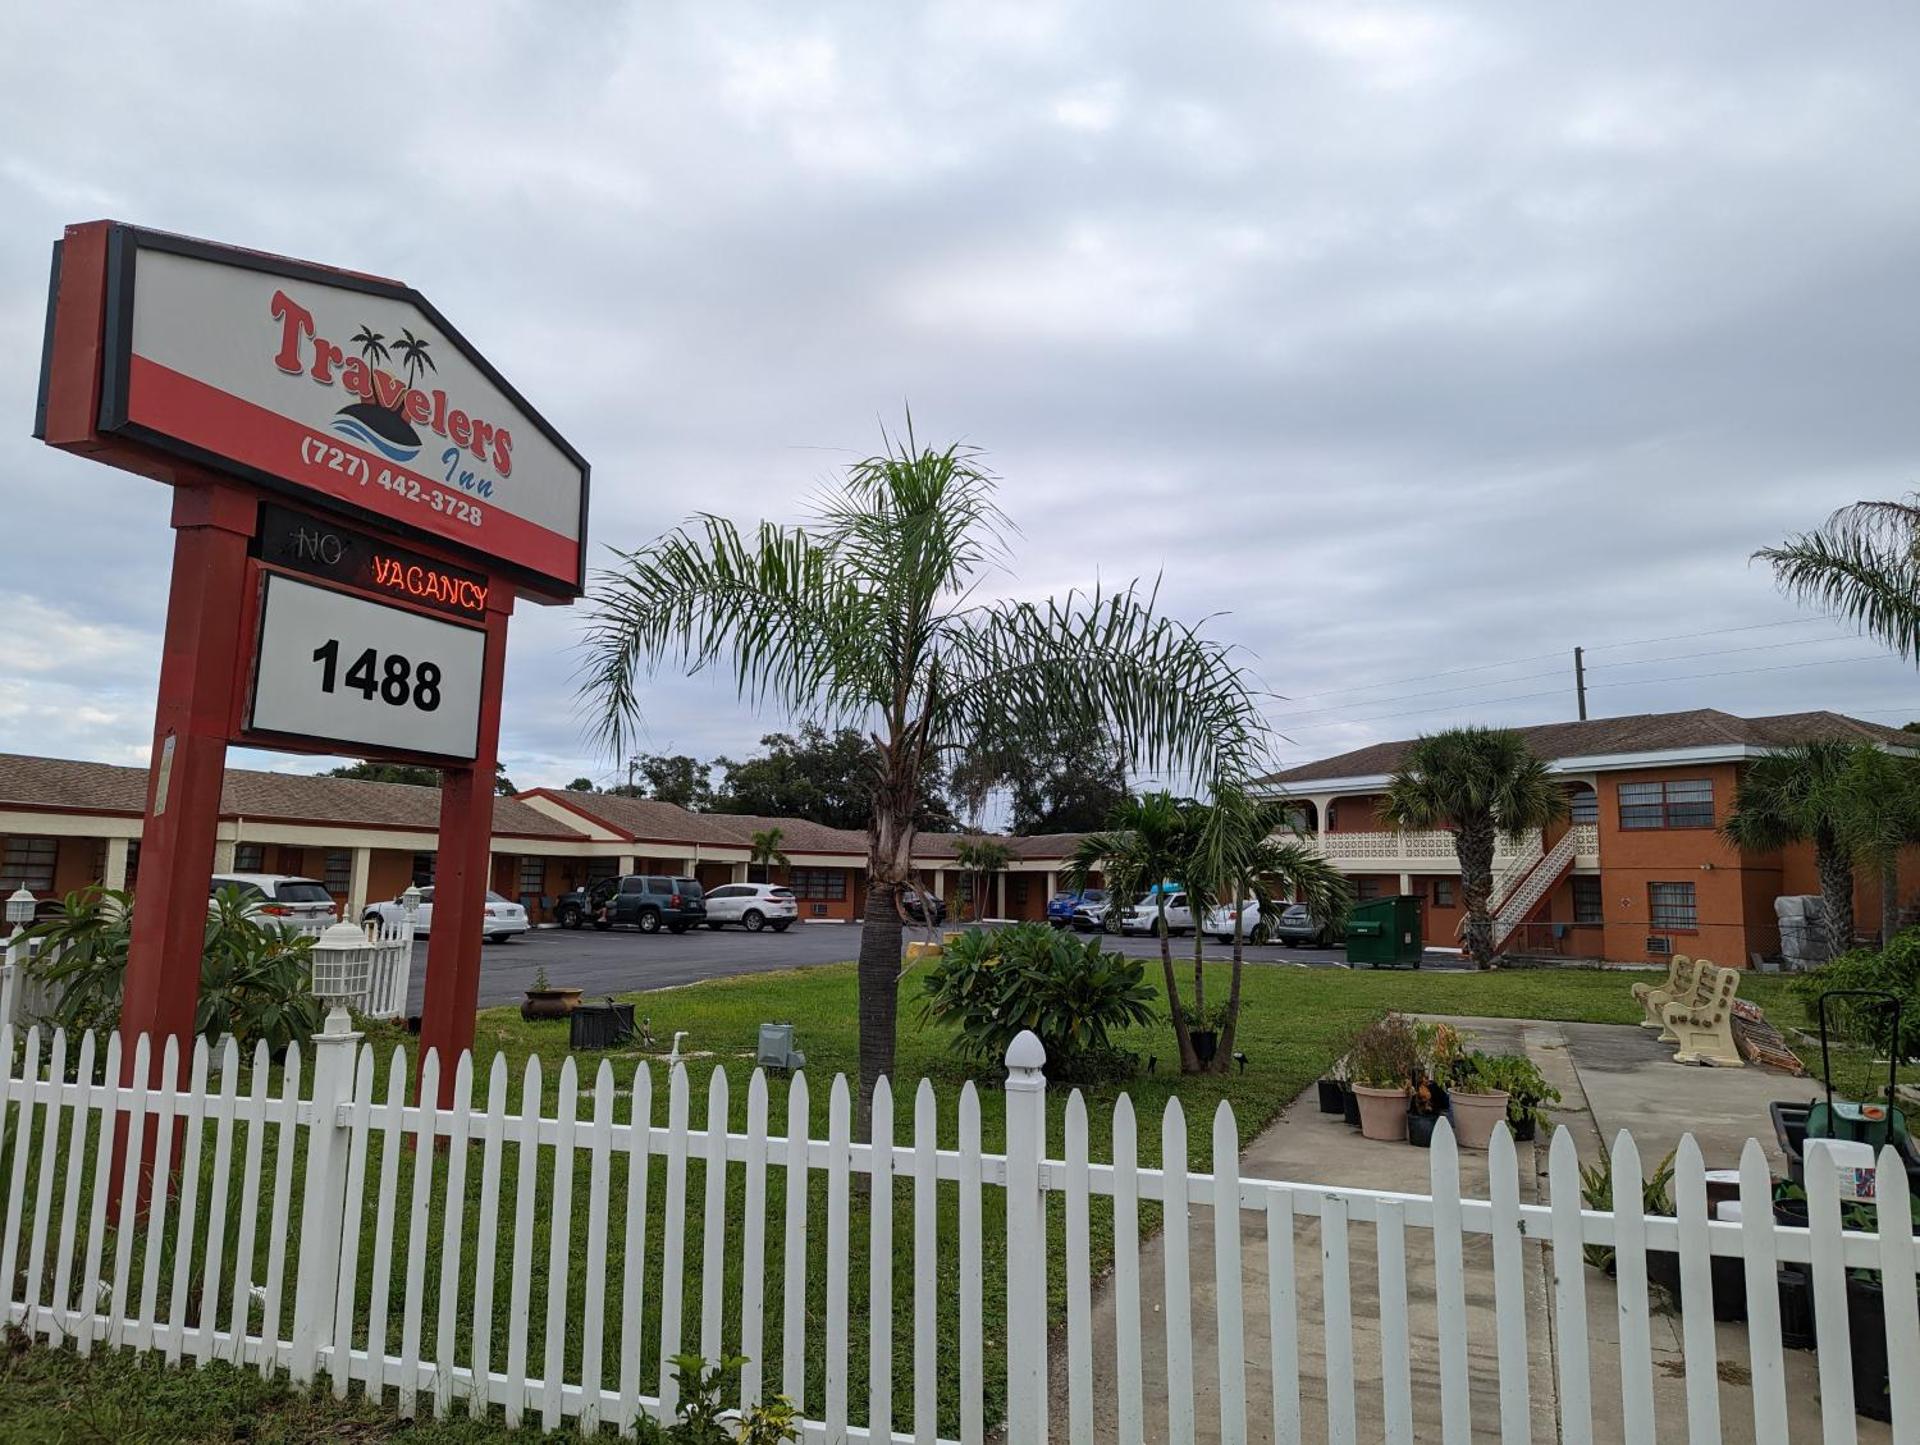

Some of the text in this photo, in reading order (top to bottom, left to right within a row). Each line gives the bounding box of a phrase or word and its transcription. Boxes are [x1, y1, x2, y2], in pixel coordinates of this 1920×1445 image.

[271, 290, 513, 478] Travelers
[301, 436, 483, 527] (727) 442-3728
[441, 447, 494, 498] Inn
[295, 527, 488, 610] NO VACANCY
[313, 639, 441, 712] 1488
